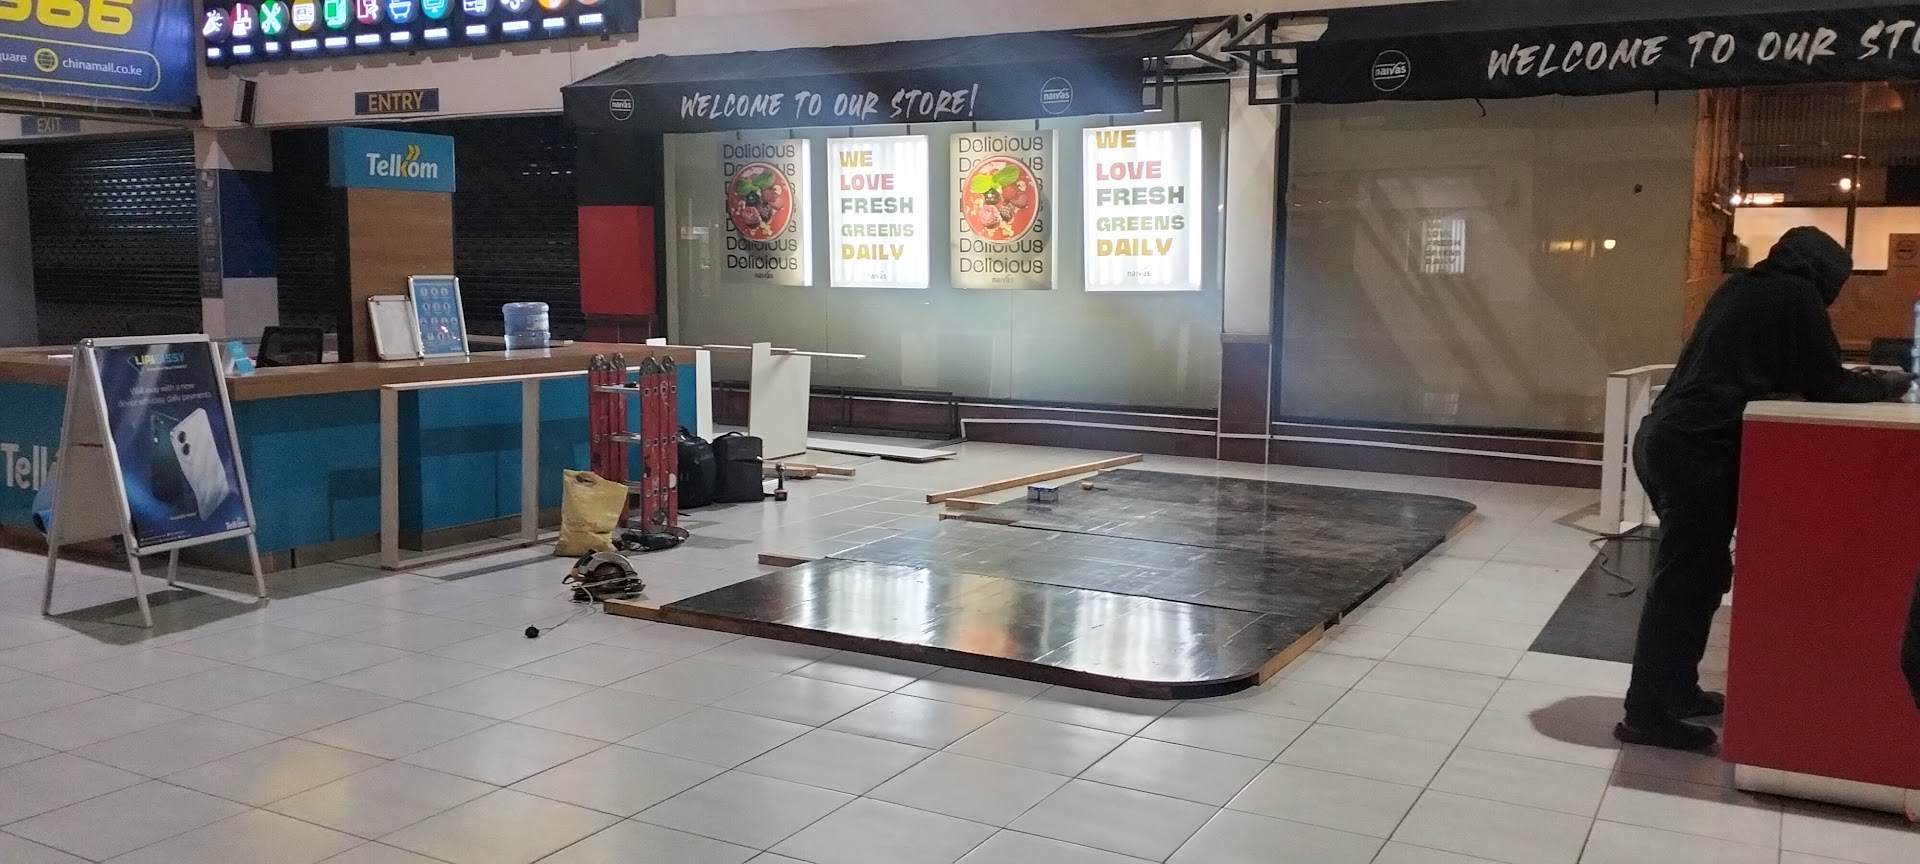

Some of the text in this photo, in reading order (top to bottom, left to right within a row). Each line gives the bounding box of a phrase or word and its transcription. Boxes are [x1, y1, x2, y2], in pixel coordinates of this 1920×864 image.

[1487, 36, 1668, 79] WELCOME
[1688, 31, 1735, 68] TO
[1758, 27, 1837, 65] OUR
[62, 58, 143, 76] chinamall.co.ke
[1375, 62, 1406, 77] naivas
[369, 92, 424, 112] ENTRY
[681, 84, 978, 120] WELCOME TO OUR STORE!
[1044, 88, 1069, 100] naivas
[612, 100, 631, 108] naivas
[37, 118, 61, 132] EXIT
[959, 136, 1043, 153] Delicious
[1096, 130, 1136, 149] WE
[723, 144, 795, 159] Delicious
[840, 151, 872, 167] WE
[366, 145, 438, 178] Telkom
[1096, 160, 1161, 180] LOVE
[840, 174, 894, 191] LOVE
[1096, 185, 1184, 206] FRESH
[841, 197, 913, 213] FRESH
[841, 224, 914, 237] GREENS
[1096, 215, 1184, 232] GREENS
[841, 244, 904, 260] DAILY
[1096, 238, 1173, 256] DAILY
[728, 254, 798, 269] Delicious
[960, 258, 1043, 273] Delicious
[992, 274, 1014, 283] naivas
[166, 394, 181, 402] daily
[182, 391, 212, 401] payments
[1, 443, 57, 490] Tell
